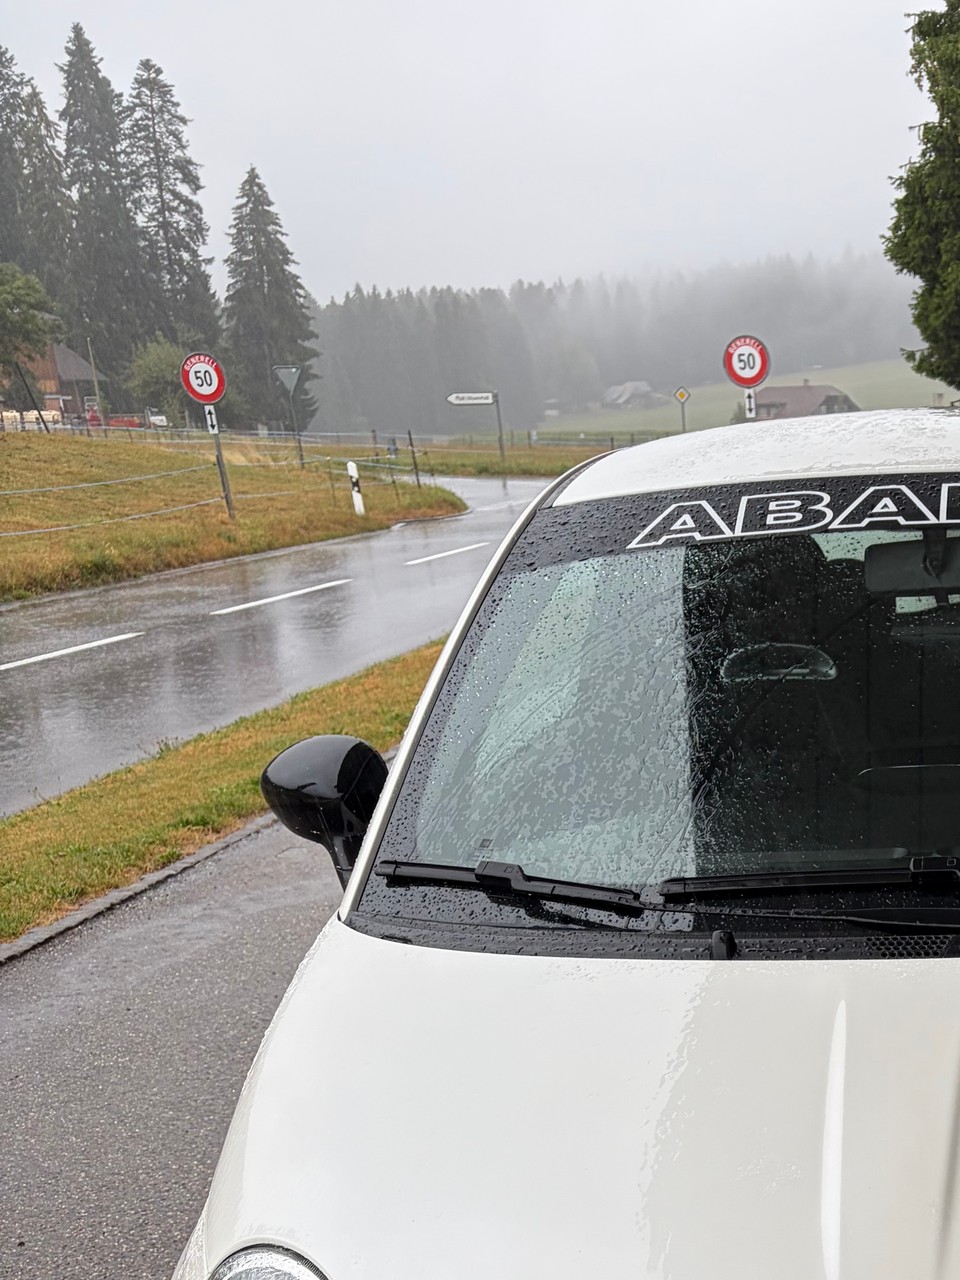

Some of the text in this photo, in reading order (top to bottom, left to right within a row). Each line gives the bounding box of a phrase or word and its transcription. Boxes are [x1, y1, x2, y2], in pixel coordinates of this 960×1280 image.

[184, 355, 217, 371] GENERELL
[738, 353, 755, 370] 50
[194, 370, 212, 387] 50
